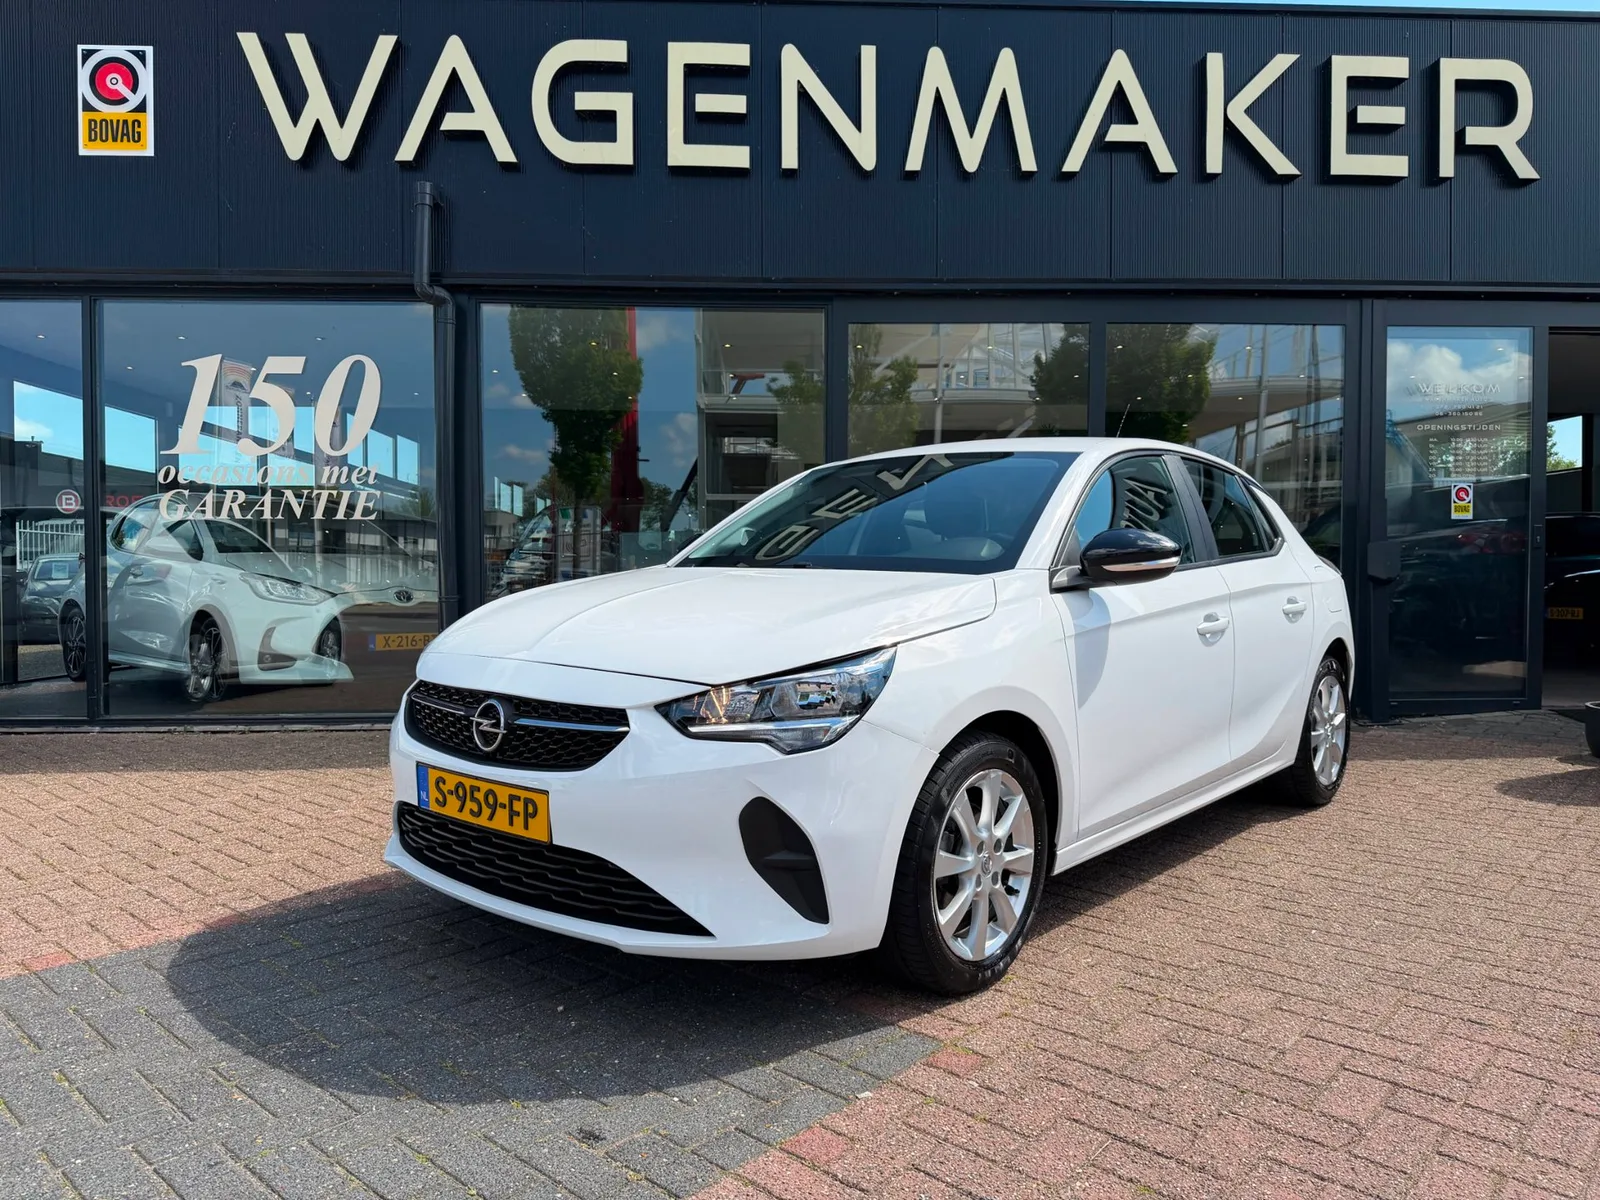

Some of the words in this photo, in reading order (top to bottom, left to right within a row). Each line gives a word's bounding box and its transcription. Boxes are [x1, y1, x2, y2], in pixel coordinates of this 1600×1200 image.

[237, 31, 1540, 184] WAGENMAKER
[88, 118, 141, 143] BOVAG
[1418, 383, 1501, 394] WELKOM
[160, 353, 382, 458] 150
[158, 464, 312, 486] occasions
[321, 463, 380, 486] met
[159, 488, 382, 522] GARANTIE
[1453, 504, 1470, 513] BOVAG
[382, 634, 438, 649] X-216-B
[420, 790, 429, 802] NL
[433, 775, 538, 831] S-959-FP
